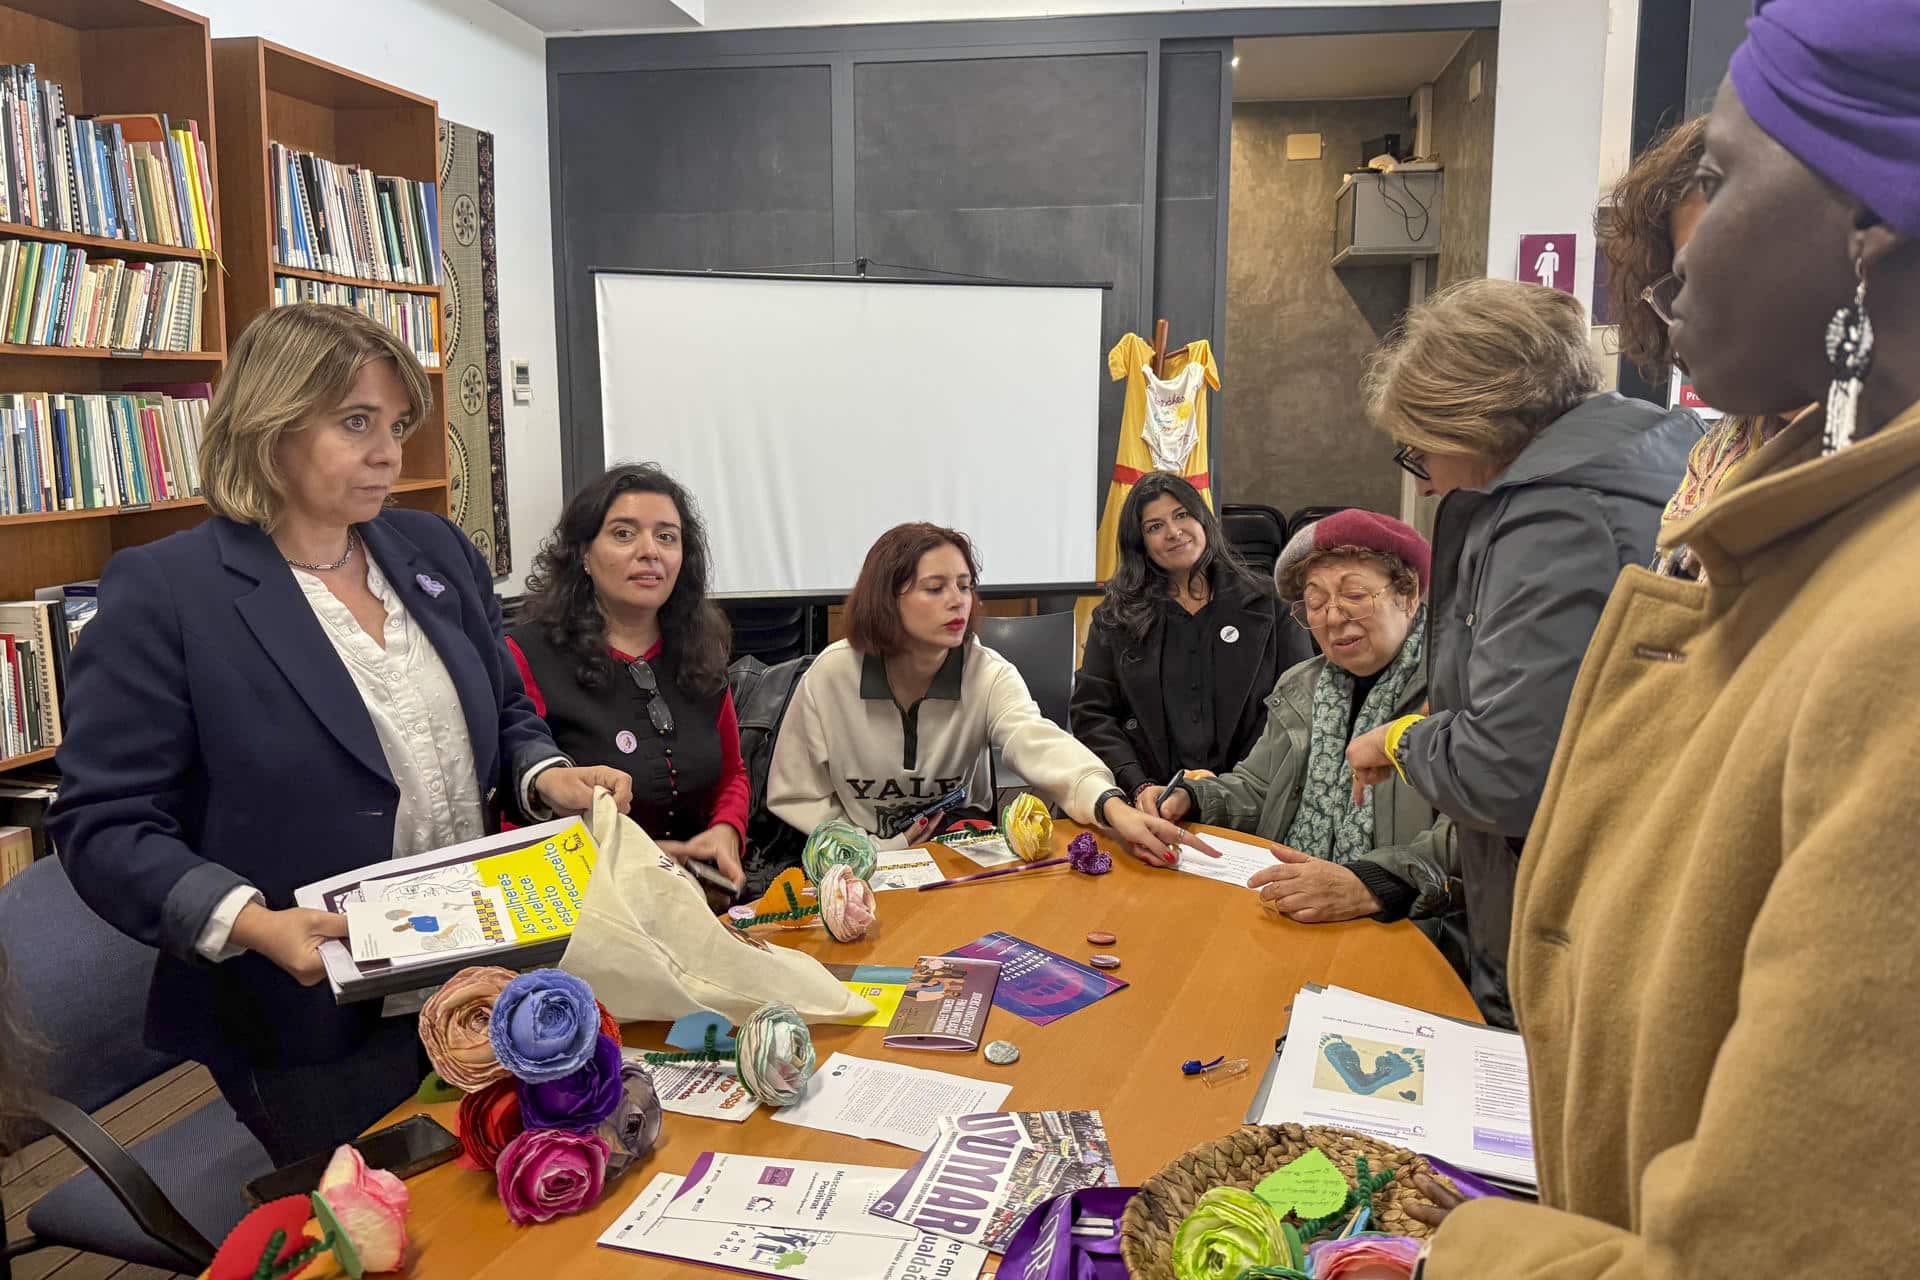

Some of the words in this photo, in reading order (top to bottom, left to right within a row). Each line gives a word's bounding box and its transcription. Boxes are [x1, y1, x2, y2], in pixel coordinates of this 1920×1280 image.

[846, 776, 962, 801] YALE
[498, 873, 529, 922] mulheres
[519, 874, 549, 917] velhice:
[544, 885, 576, 927] respeito
[523, 922, 540, 934] As
[809, 1180, 831, 1210] Positivas
[815, 1170, 845, 1221] Masculinidades
[913, 1135, 1016, 1235] UMAR
